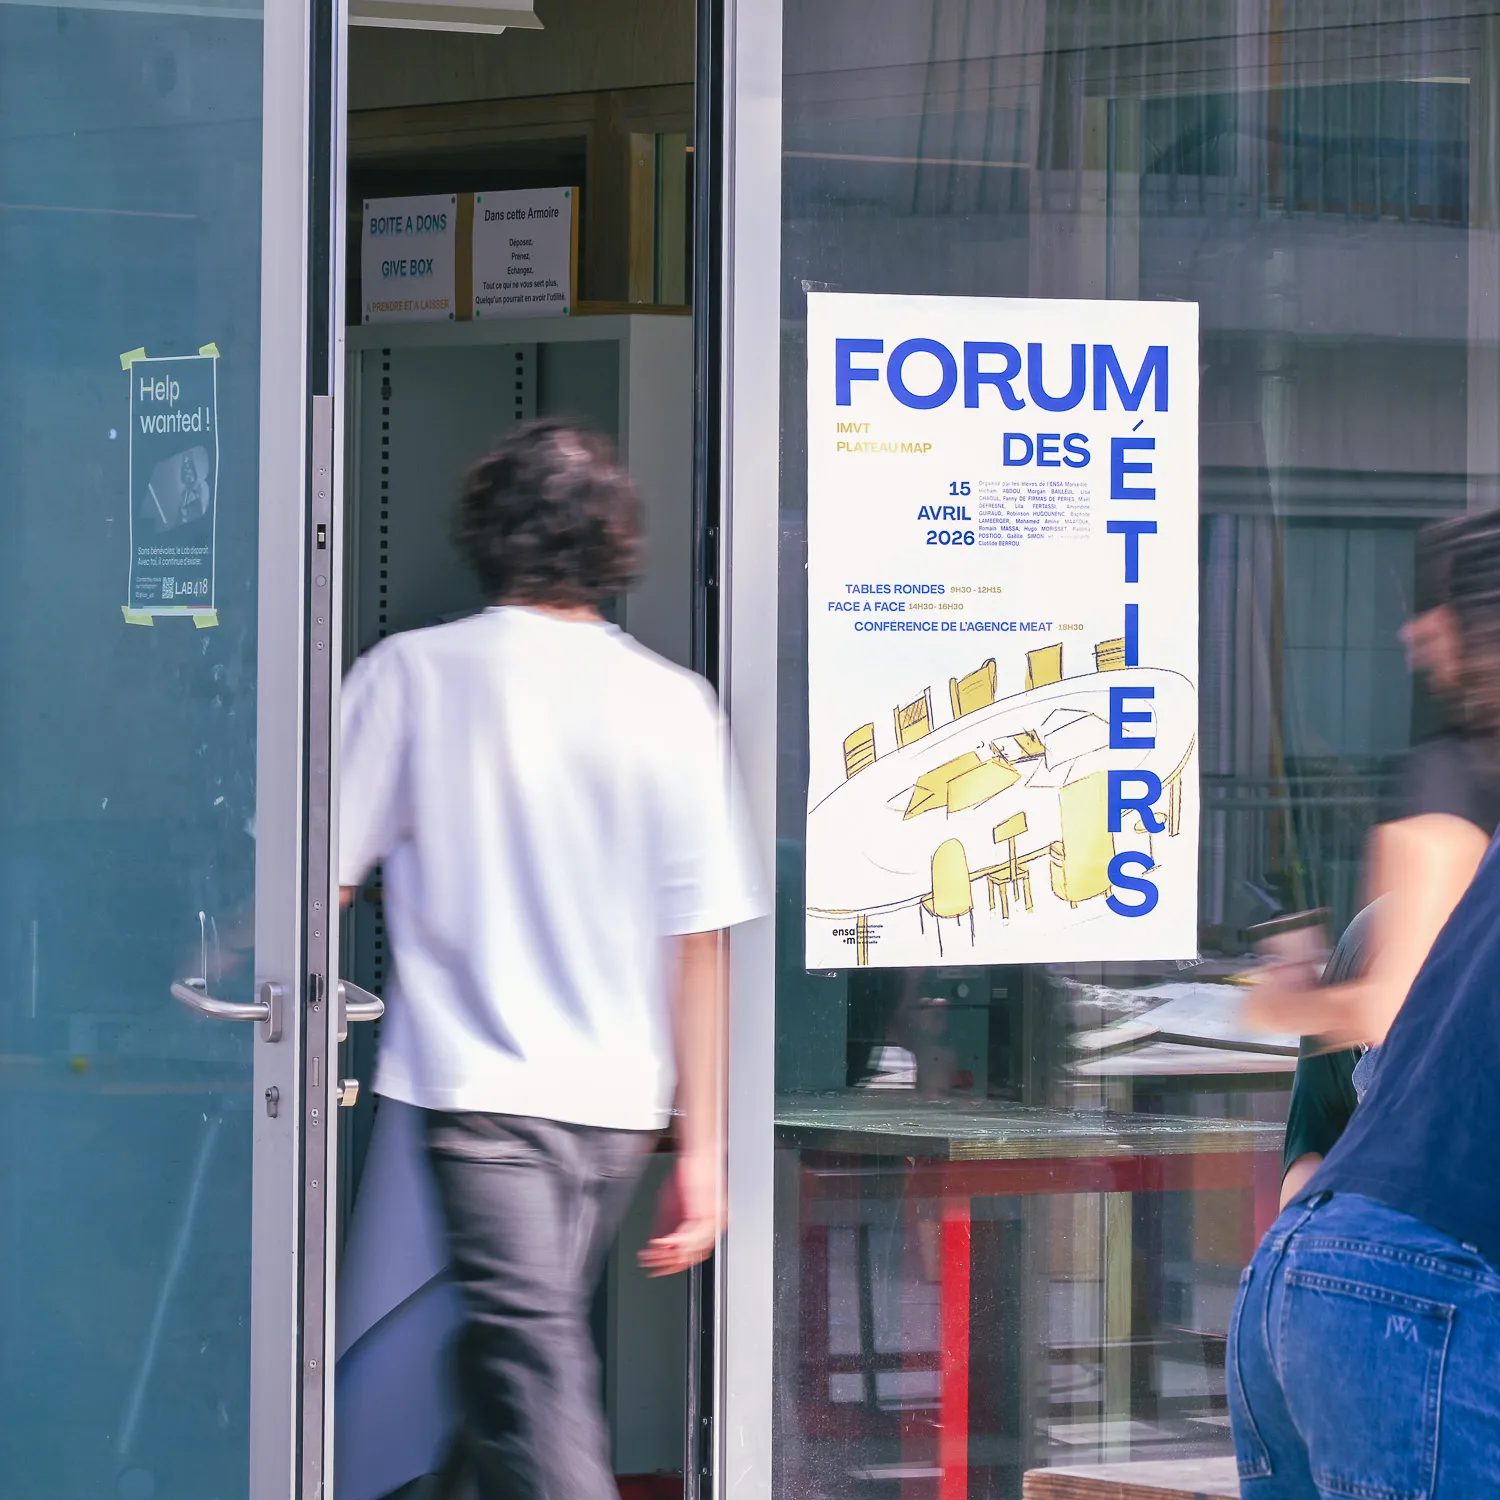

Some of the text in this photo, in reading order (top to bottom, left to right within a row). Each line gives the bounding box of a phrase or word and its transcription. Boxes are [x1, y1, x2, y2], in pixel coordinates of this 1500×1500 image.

[485, 206, 559, 221] Dans cette Armoire
[370, 214, 447, 234] BOITE A DONS
[511, 252, 530, 260] Prenez,
[382, 259, 433, 277] GIVE BOX
[483, 281, 495, 290] Tout
[503, 281, 511, 290] qui
[503, 294, 524, 304] pourrait
[532, 293, 546, 302] avoir
[372, 301, 403, 312] PRENDRE
[404, 301, 412, 311] ET
[420, 299, 449, 310] LAISSER
[835, 338, 1169, 412] FORUM
[140, 374, 180, 407] Help
[140, 406, 210, 434] wanted !
[836, 422, 871, 433] IMVT
[836, 441, 932, 454] PLATEAU MAP
[1003, 432, 1091, 468] DES
[949, 482, 971, 496] 15
[917, 506, 972, 521] AVRIL
[926, 530, 976, 546] 2026
[138, 546, 150, 555] Sans
[138, 558, 150, 566] Avec
[845, 584, 891, 594] TABLES
[894, 584, 945, 594] RONDES
[950, 586, 972, 594] 9H30
[977, 586, 1002, 594] 12H15
[828, 601, 860, 612] FACE
[863, 600, 872, 612] À
[874, 601, 905, 612] FACE
[854, 620, 938, 632] CONFÉRENCE
[941, 622, 957, 632] DE
[1019, 622, 1053, 632] MEAT
[832, 928, 855, 936] ensa
